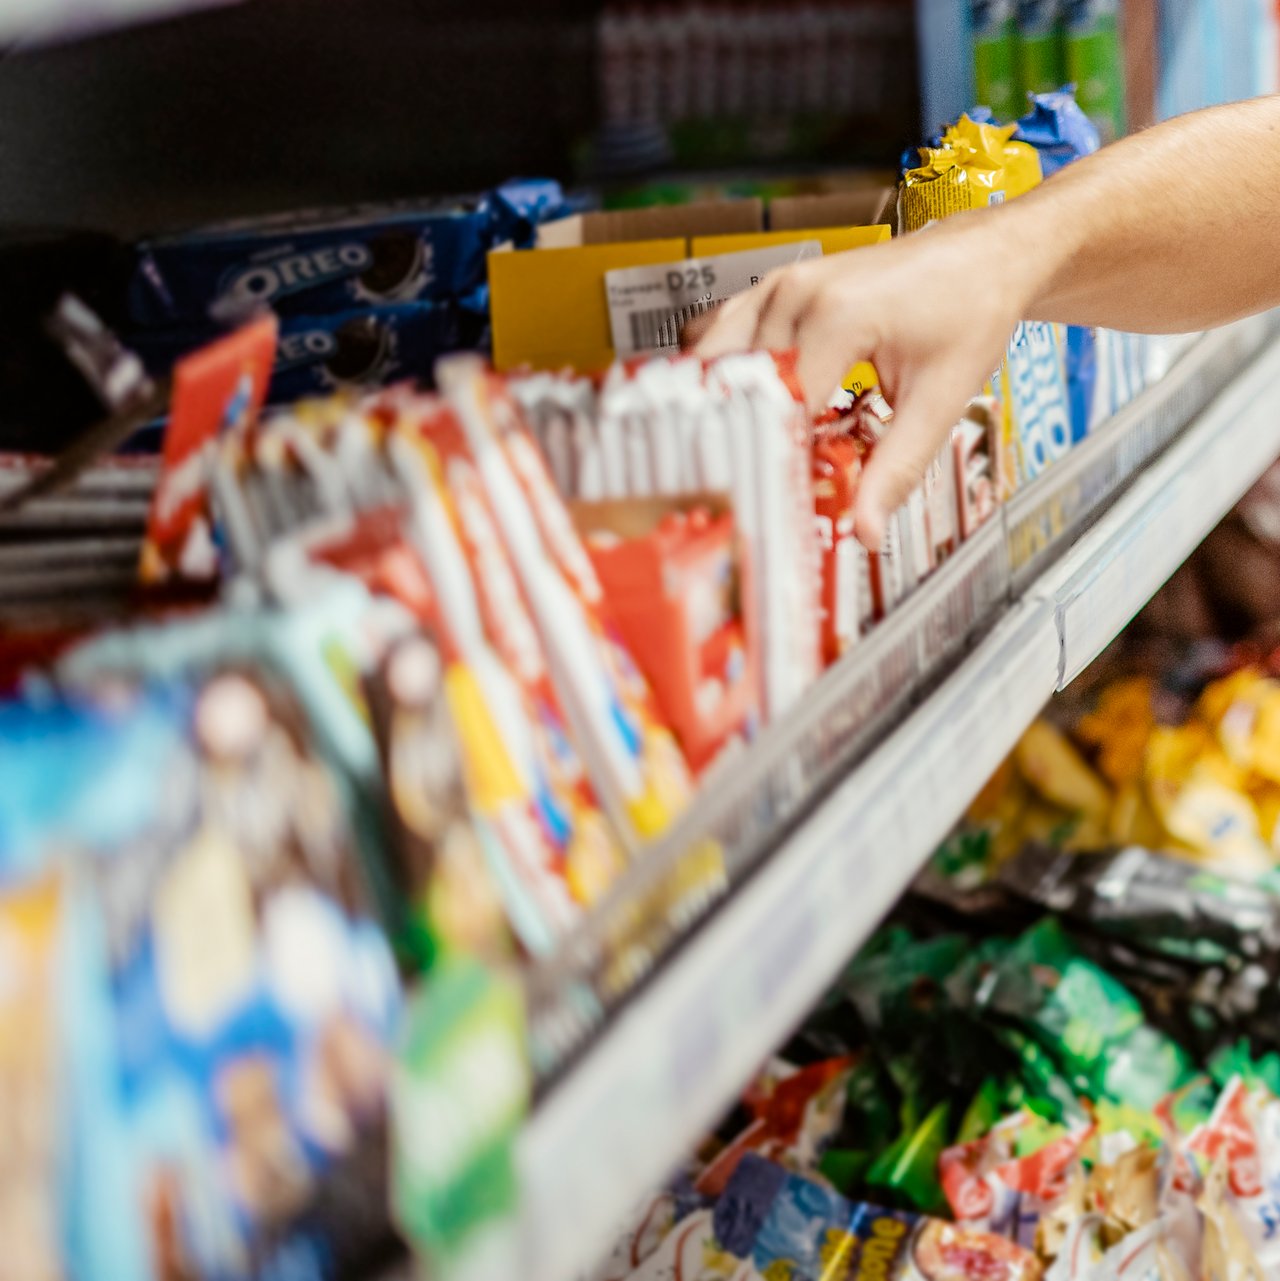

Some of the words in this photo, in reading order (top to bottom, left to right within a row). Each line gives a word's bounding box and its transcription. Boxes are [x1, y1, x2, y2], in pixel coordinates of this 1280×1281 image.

[235, 245, 368, 301] OREO
[666, 265, 716, 291] D25
[852, 380, 863, 391] (1)
